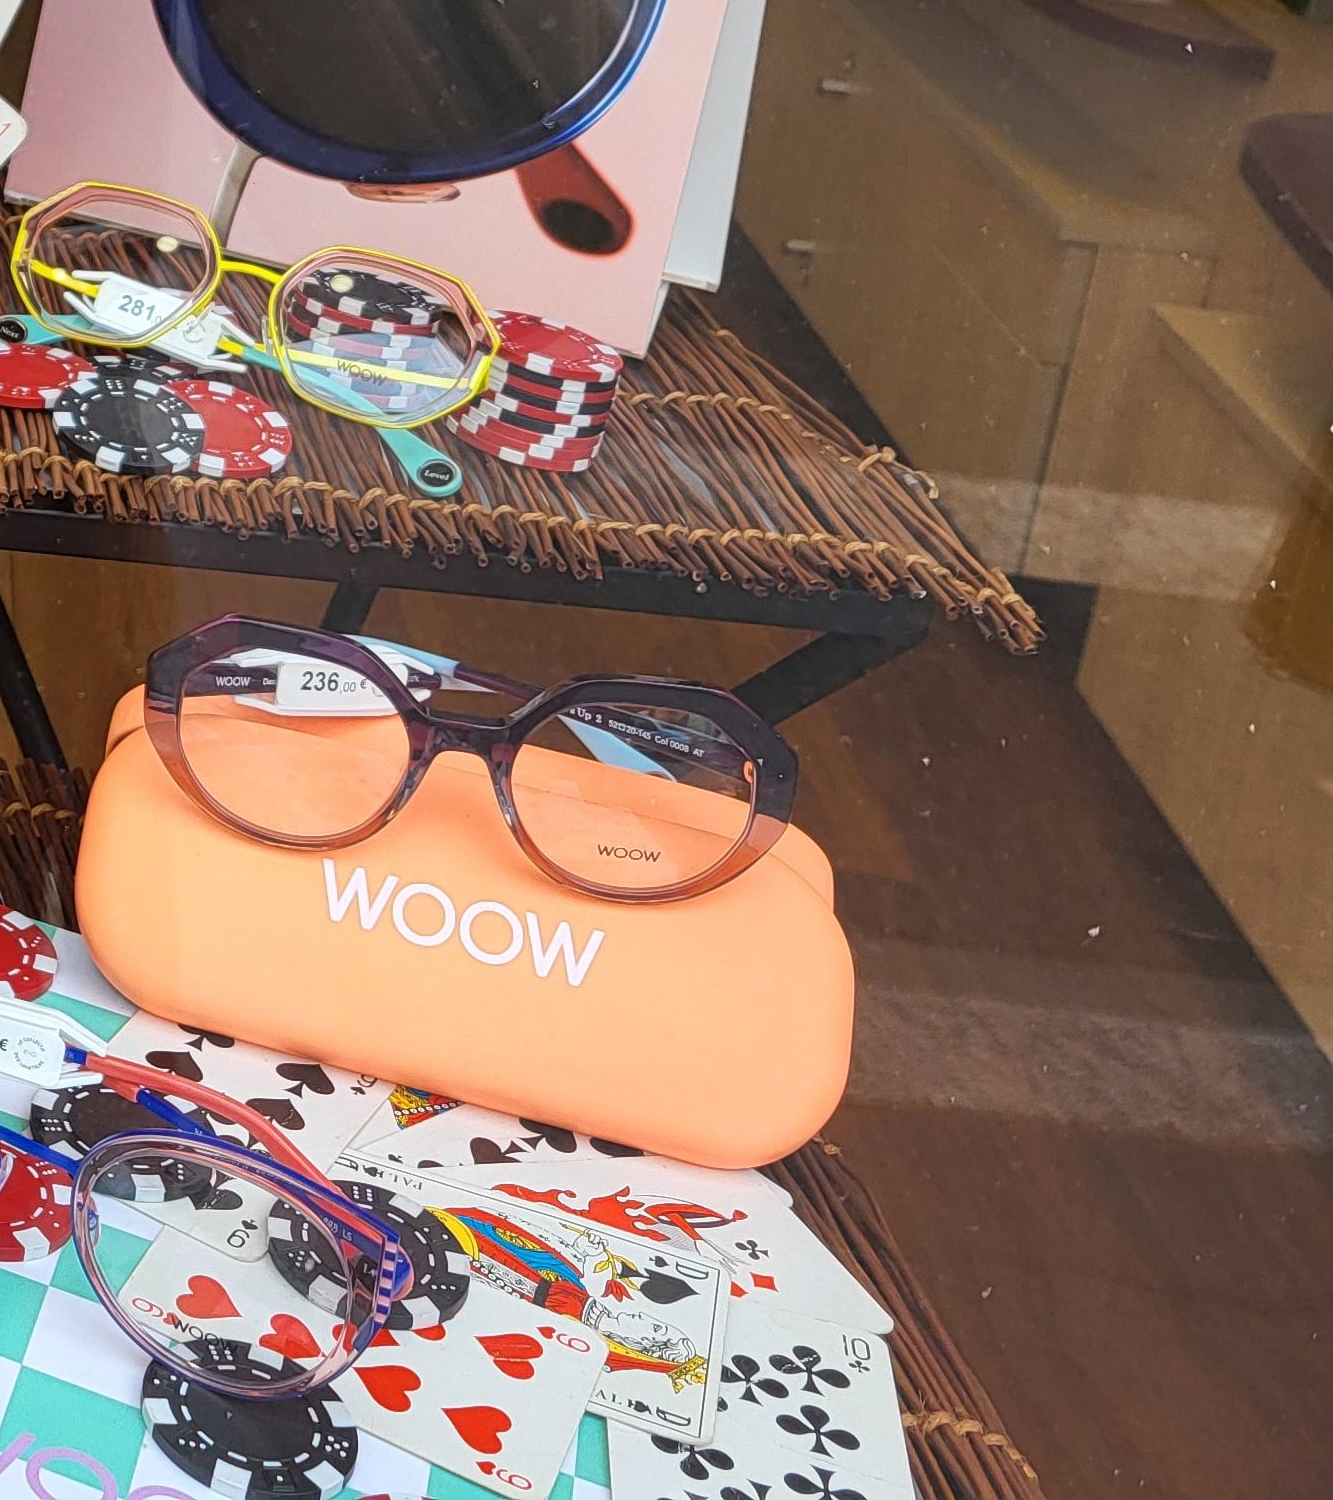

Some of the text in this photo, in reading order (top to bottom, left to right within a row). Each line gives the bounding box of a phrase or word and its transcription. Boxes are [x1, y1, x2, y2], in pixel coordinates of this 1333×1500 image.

[337, 360, 388, 387] WOOW
[423, 469, 451, 481] Level
[215, 675, 252, 687] WOOW
[300, 670, 357, 695] 236,00
[576, 706, 592, 721] Up
[654, 735, 669, 748] Col
[692, 747, 705, 758] AT
[596, 843, 662, 863] WOOW
[323, 858, 605, 988] WOOW
[675, 1261, 710, 1280] D
[841, 1334, 872, 1362] 10
